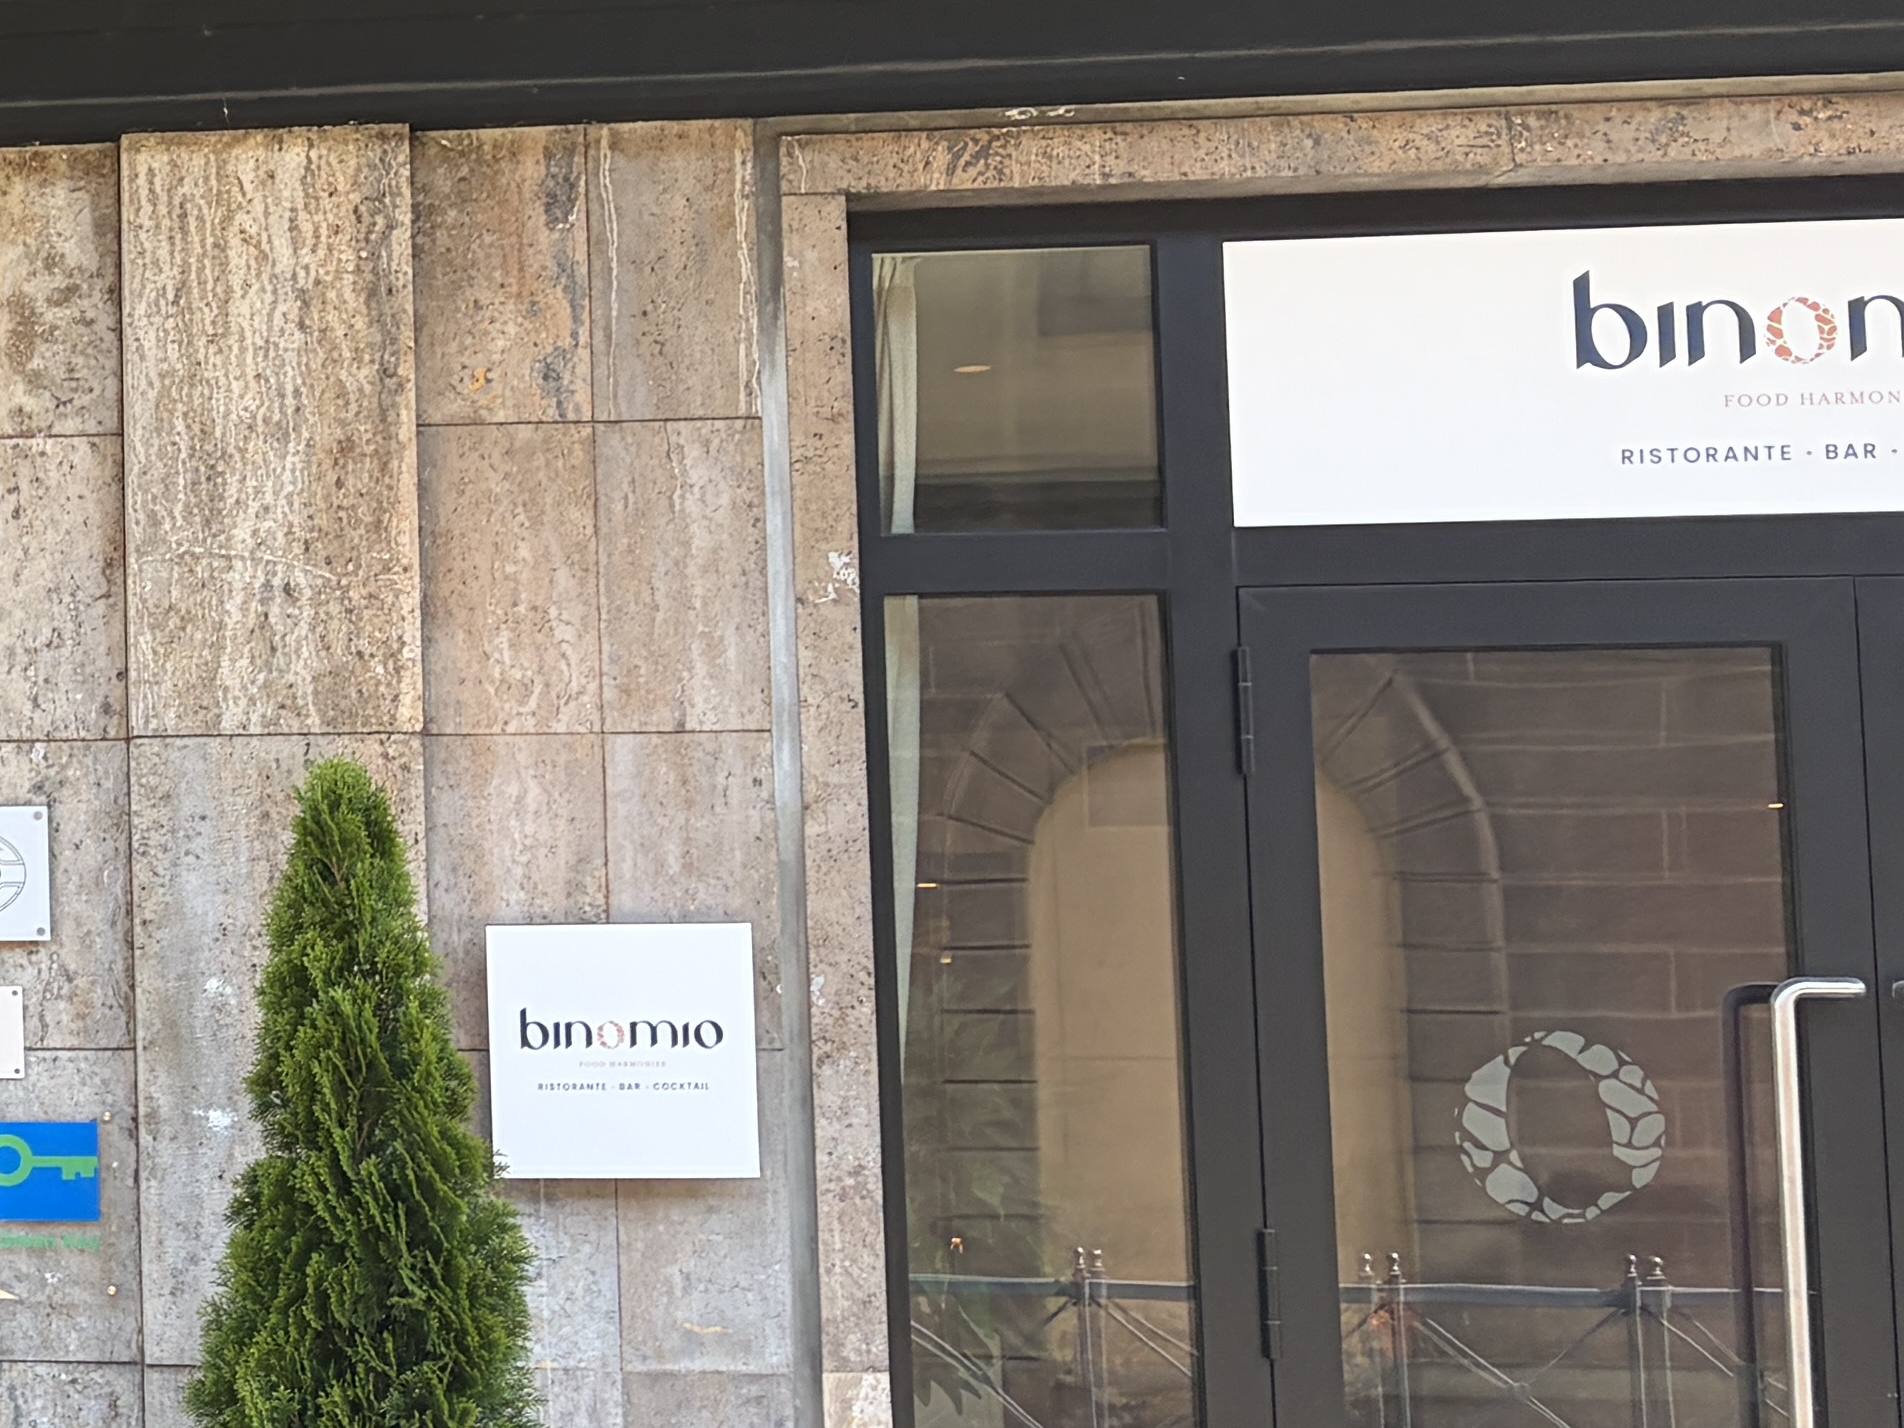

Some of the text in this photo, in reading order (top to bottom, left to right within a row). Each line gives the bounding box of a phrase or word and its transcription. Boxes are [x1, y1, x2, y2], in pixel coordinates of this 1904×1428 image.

[1723, 393, 1789, 408] FOOD
[1620, 442, 1877, 465] RISTORANTE BAR
[519, 1007, 724, 1050] binomio
[578, 1060, 667, 1068] FOOD HARMONIES
[537, 1081, 710, 1091] RISTORANTE BAR COCKTAIL
